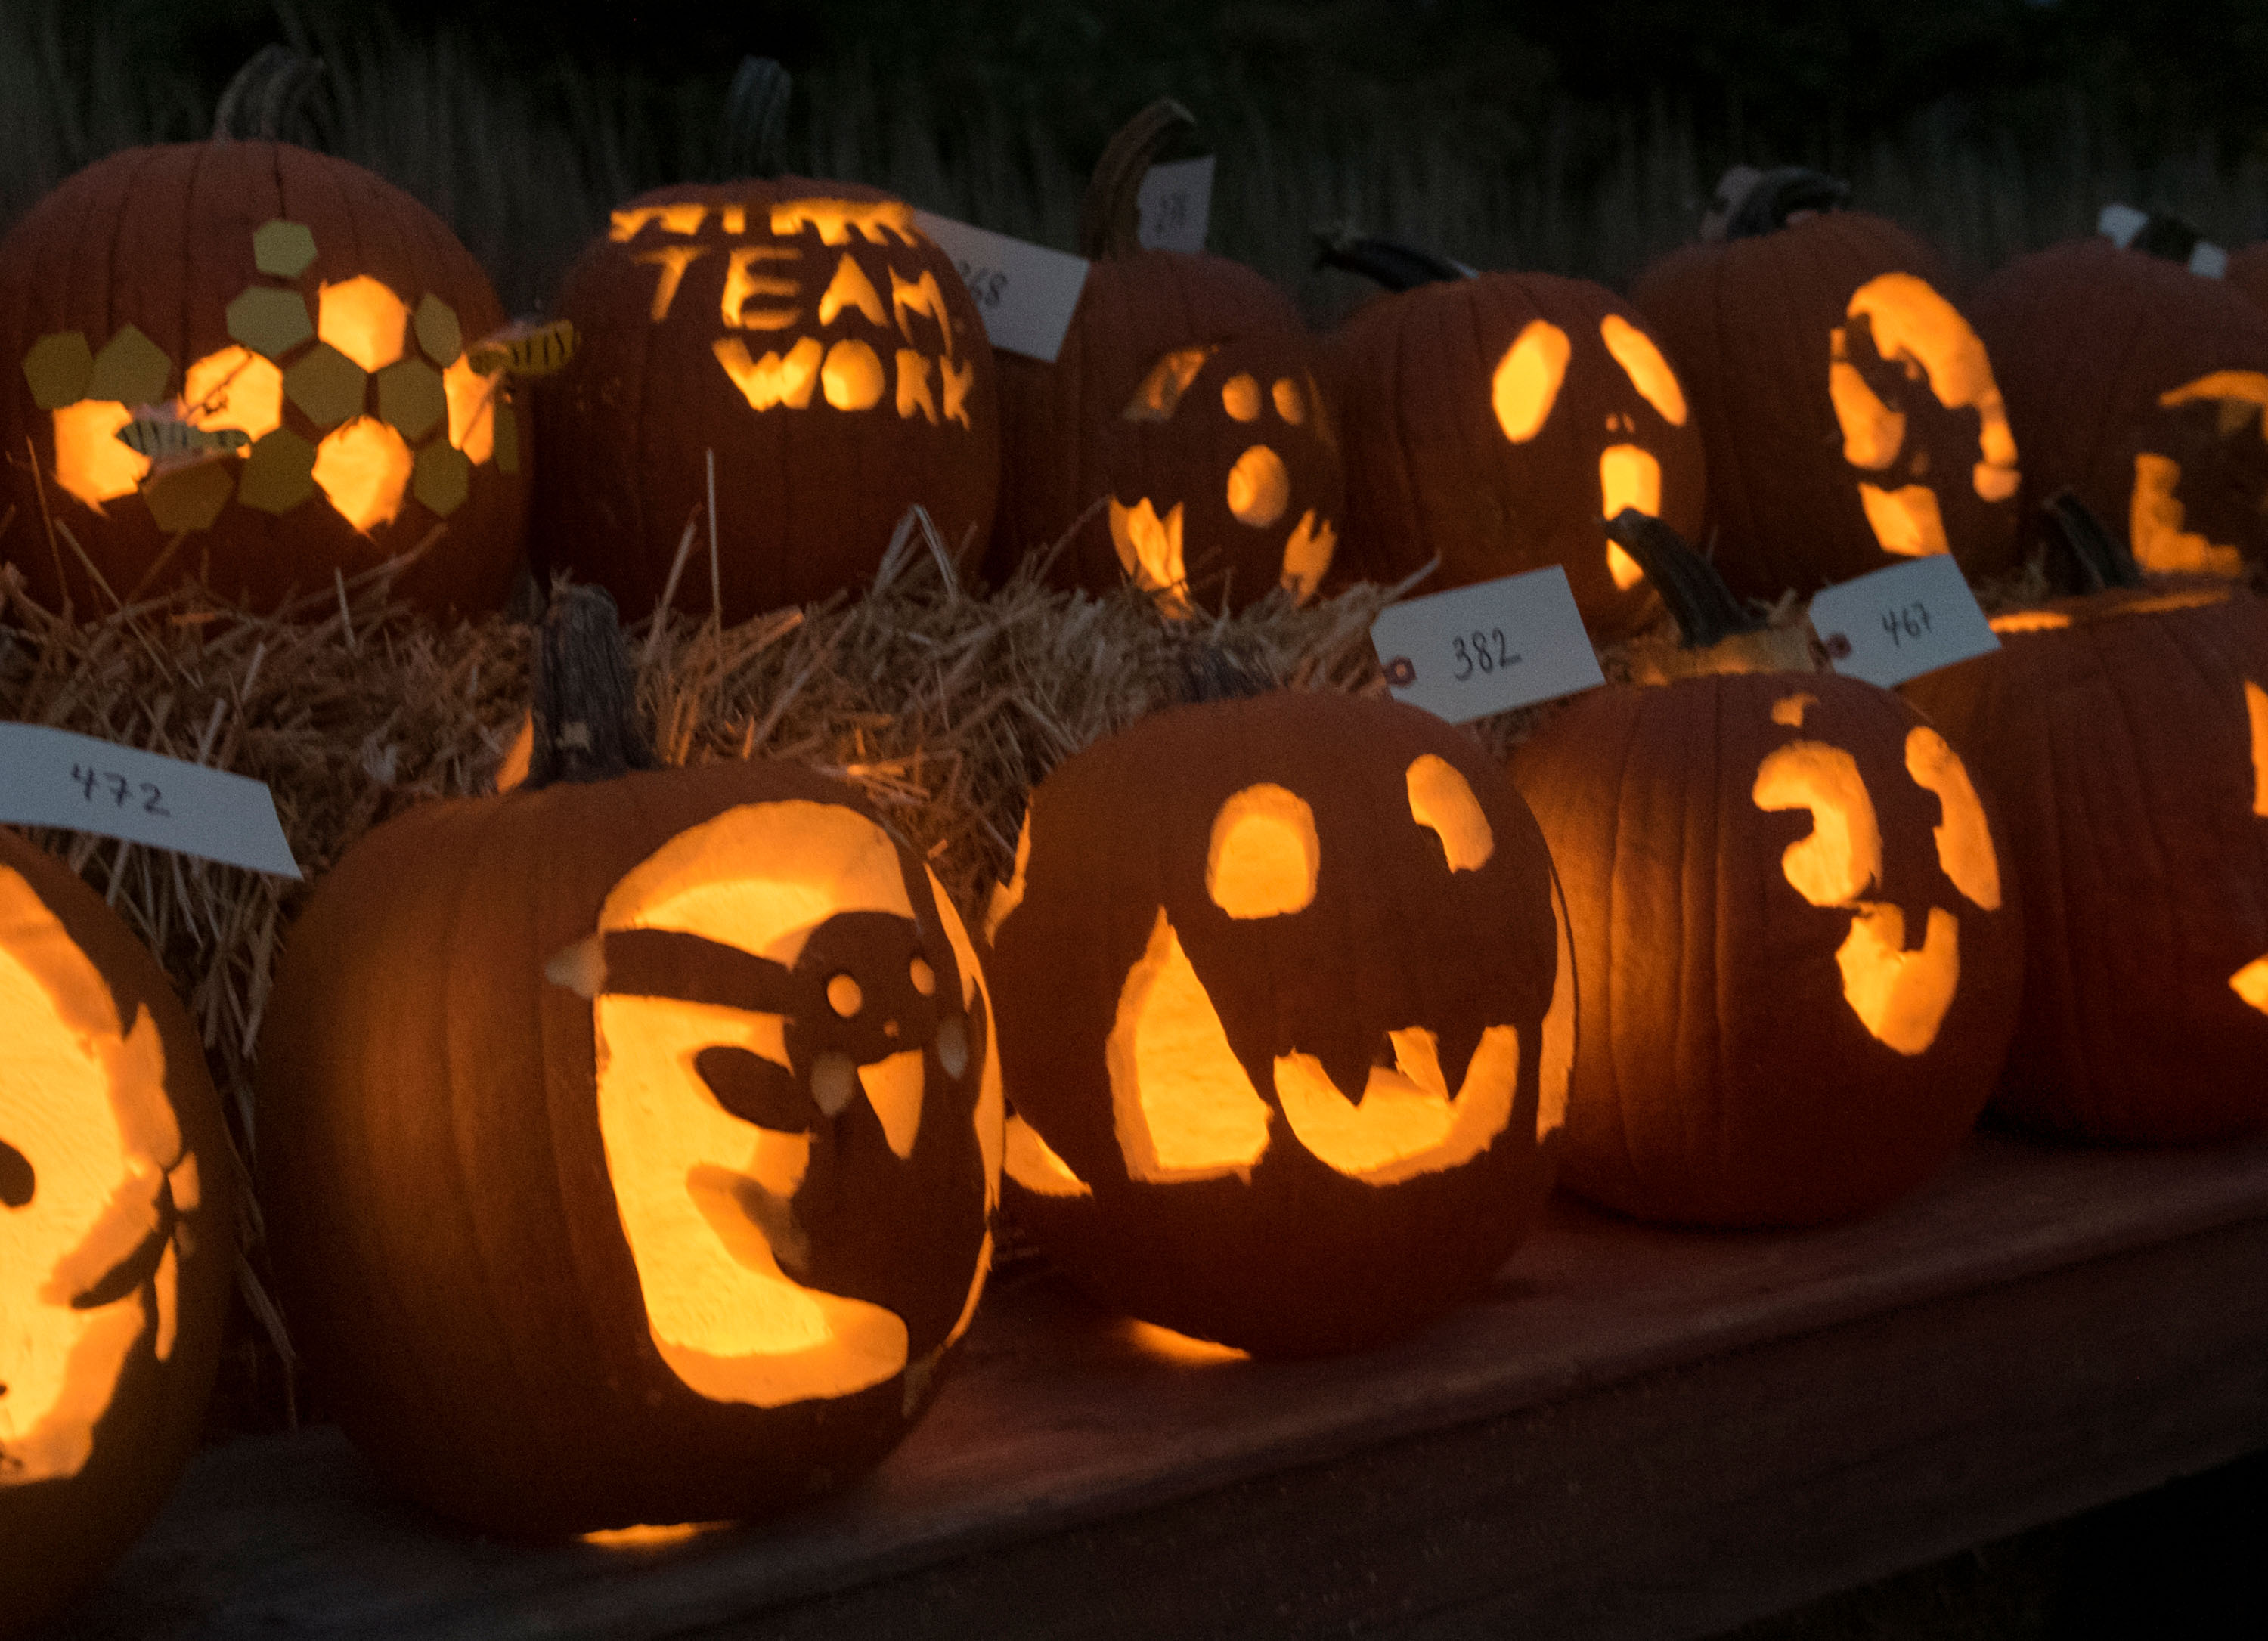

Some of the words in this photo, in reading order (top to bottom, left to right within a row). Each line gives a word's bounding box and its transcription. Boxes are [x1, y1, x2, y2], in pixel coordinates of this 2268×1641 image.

[631, 246, 953, 358] TEAM
[711, 336, 974, 432] WORK
[1881, 601, 1932, 646] 467
[1452, 627, 1523, 681] 382
[71, 763, 171, 819] 472
